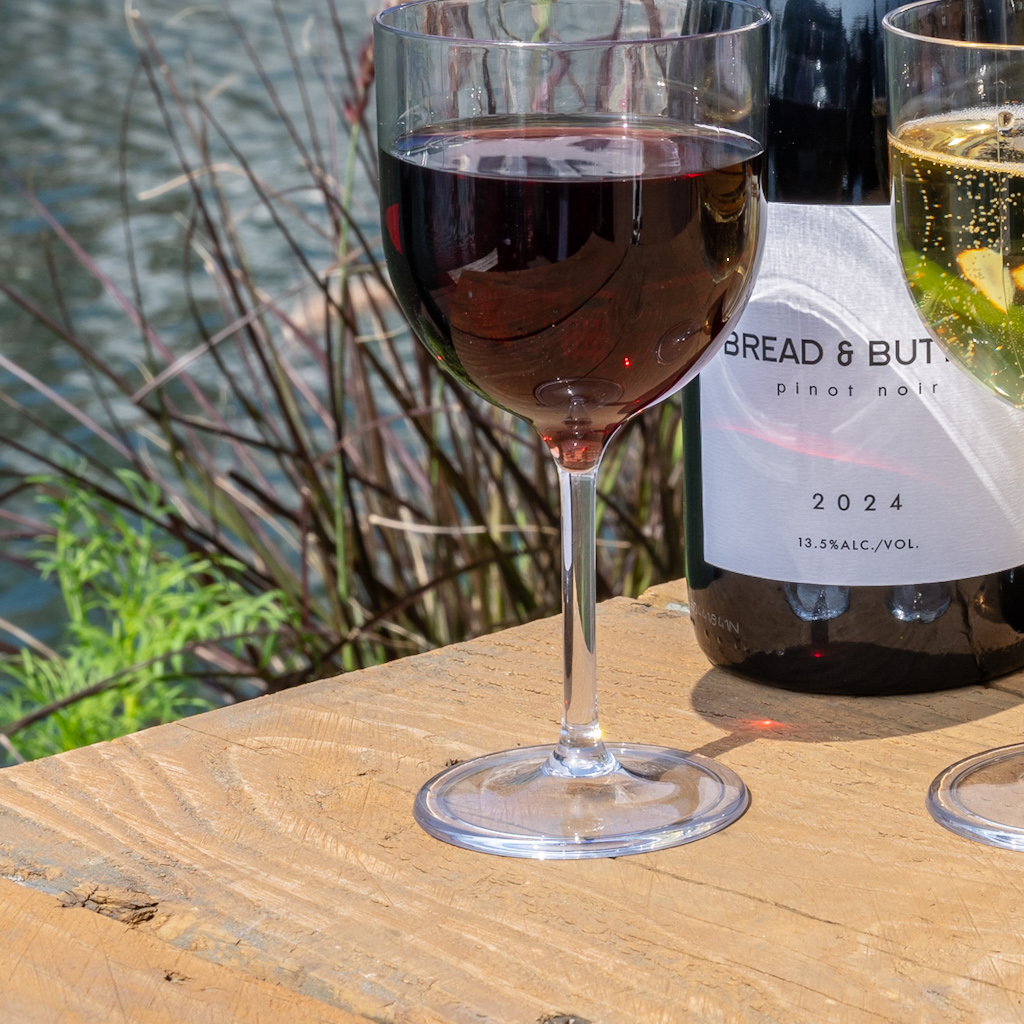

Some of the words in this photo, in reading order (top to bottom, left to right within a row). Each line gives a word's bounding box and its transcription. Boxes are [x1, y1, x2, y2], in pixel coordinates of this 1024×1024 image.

[723, 330, 824, 366] BREAD
[836, 339, 854, 367] &
[868, 337, 950, 367] BUT
[776, 381, 854, 397] pinot
[877, 381, 939, 397] noir
[812, 492, 903, 512] 2024
[797, 536, 920, 554] 13.5%ALC./VOL.
